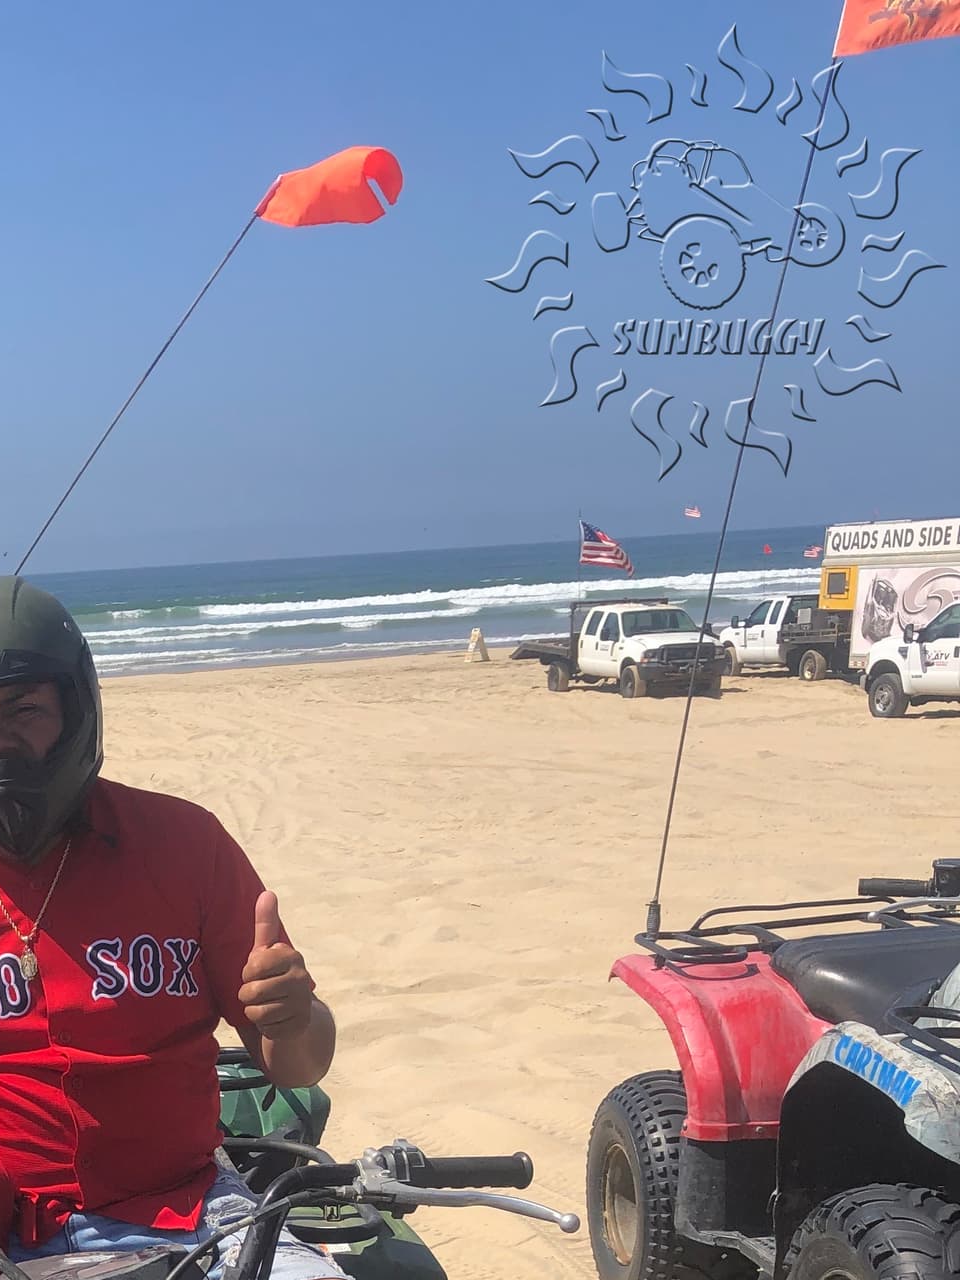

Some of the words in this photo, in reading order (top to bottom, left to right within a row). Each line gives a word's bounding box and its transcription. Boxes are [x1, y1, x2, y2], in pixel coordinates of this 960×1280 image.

[831, 530, 878, 552] QUADS
[881, 528, 914, 549] AND
[918, 525, 952, 547] SIDE
[86, 934, 200, 1001] SOX
[834, 1033, 922, 1106] CARTMAN
